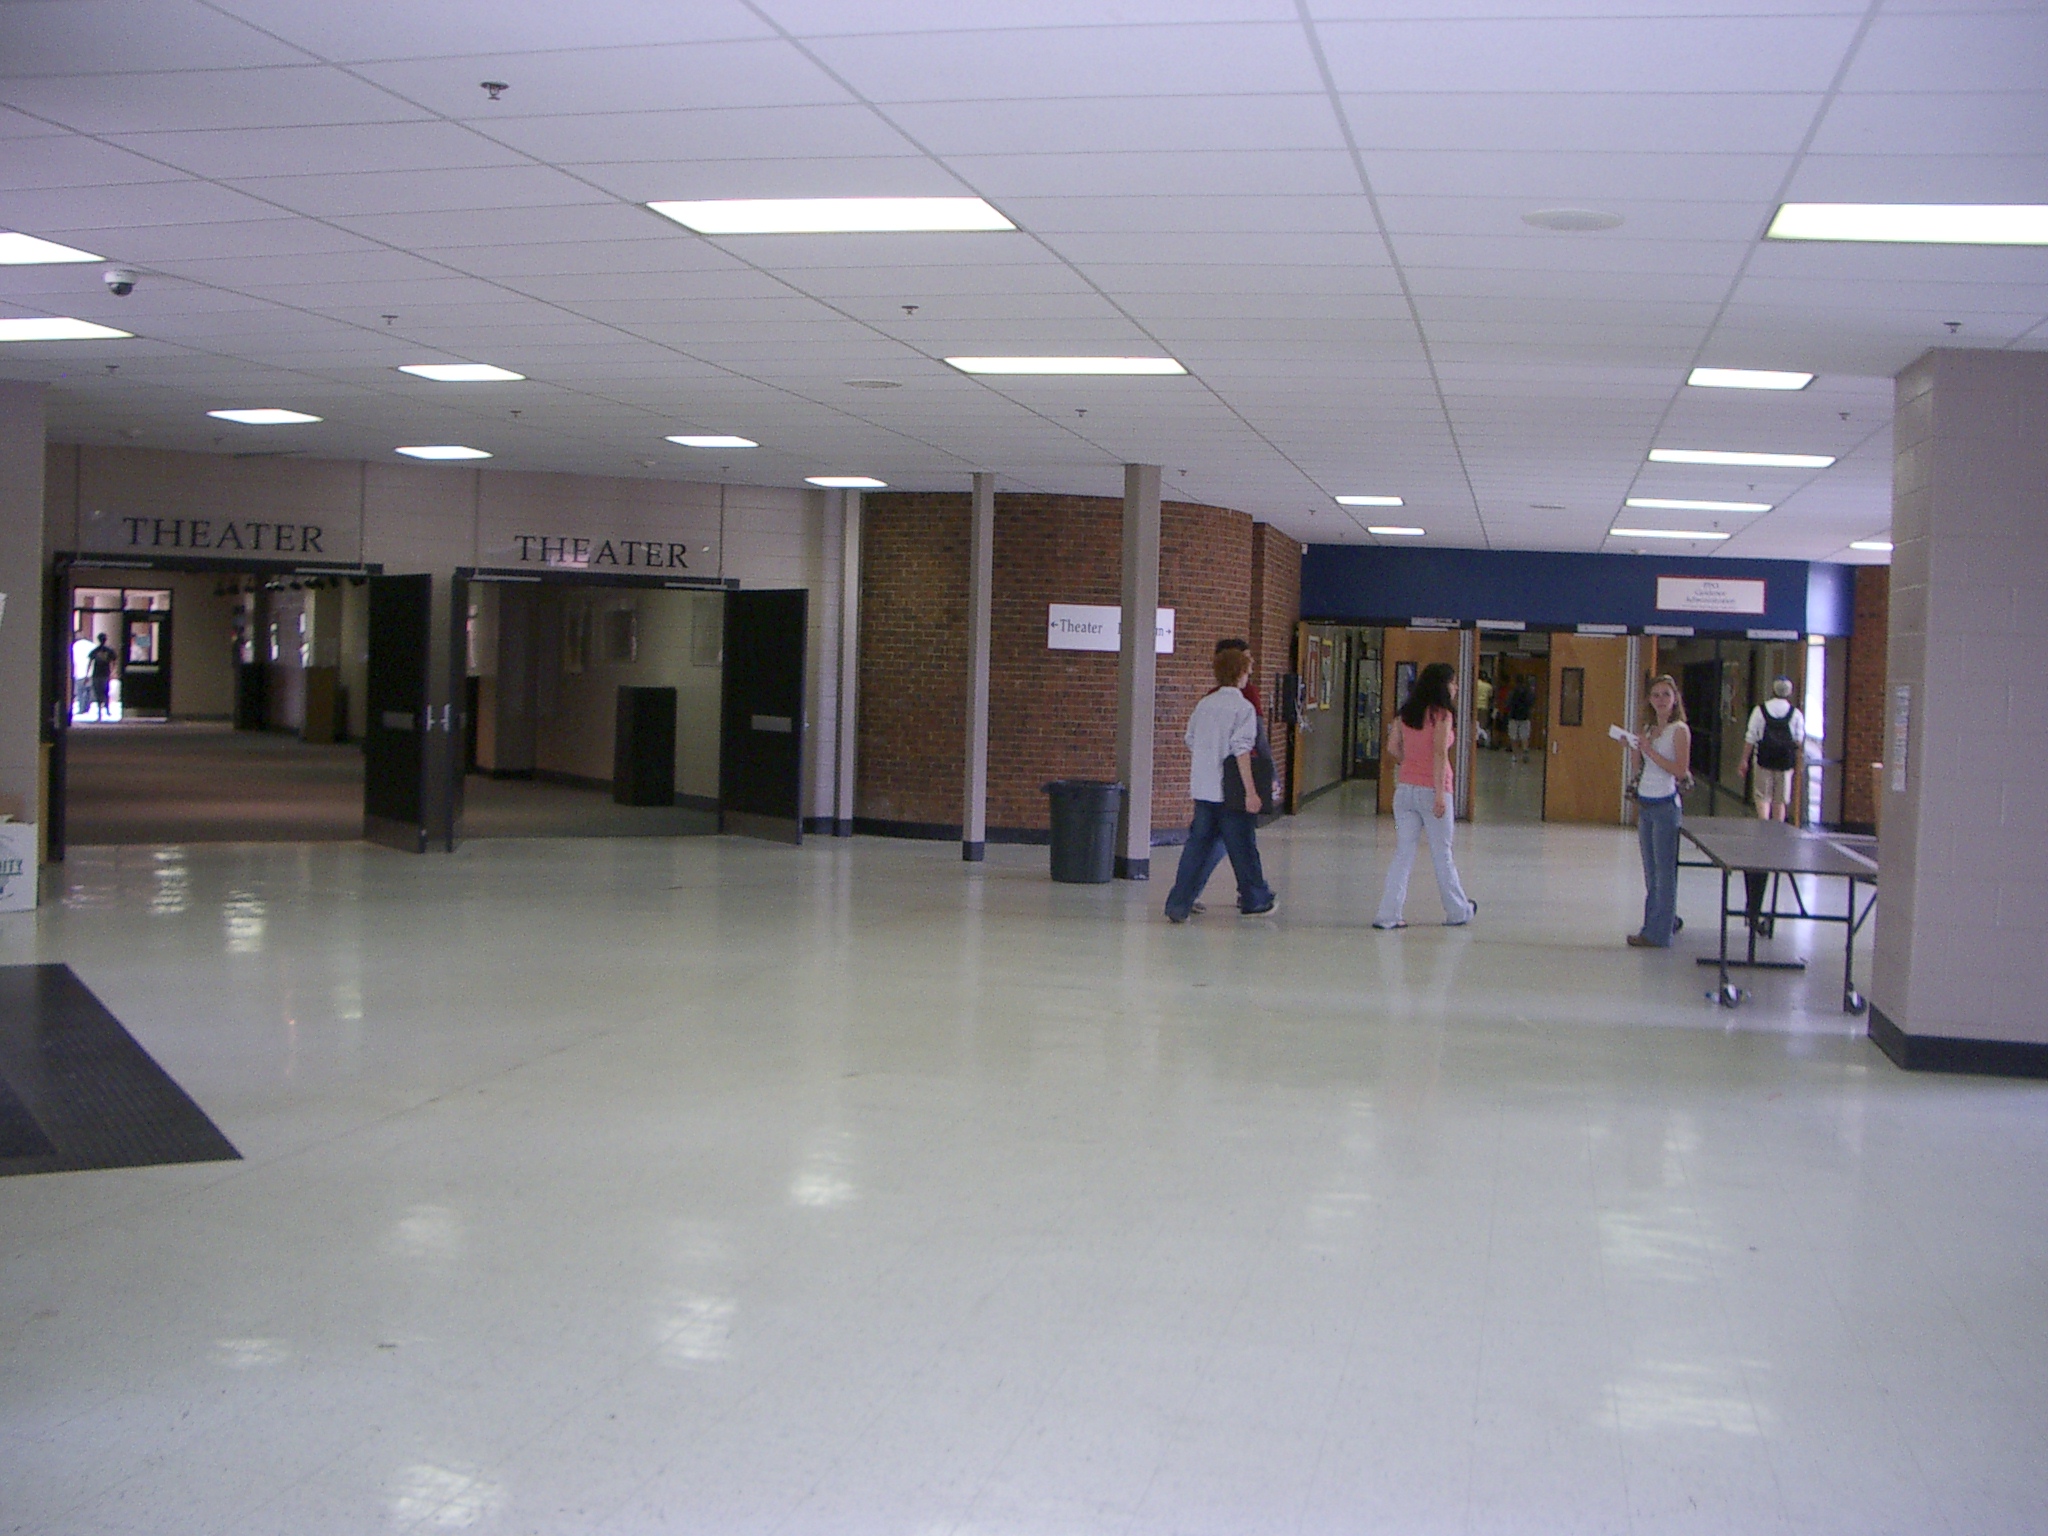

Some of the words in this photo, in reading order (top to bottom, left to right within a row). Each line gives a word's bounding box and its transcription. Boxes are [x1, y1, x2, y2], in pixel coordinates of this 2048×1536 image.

[122, 516, 323, 553] THEATER
[514, 535, 689, 569] THEATER
[1060, 618, 1103, 635] Theater
